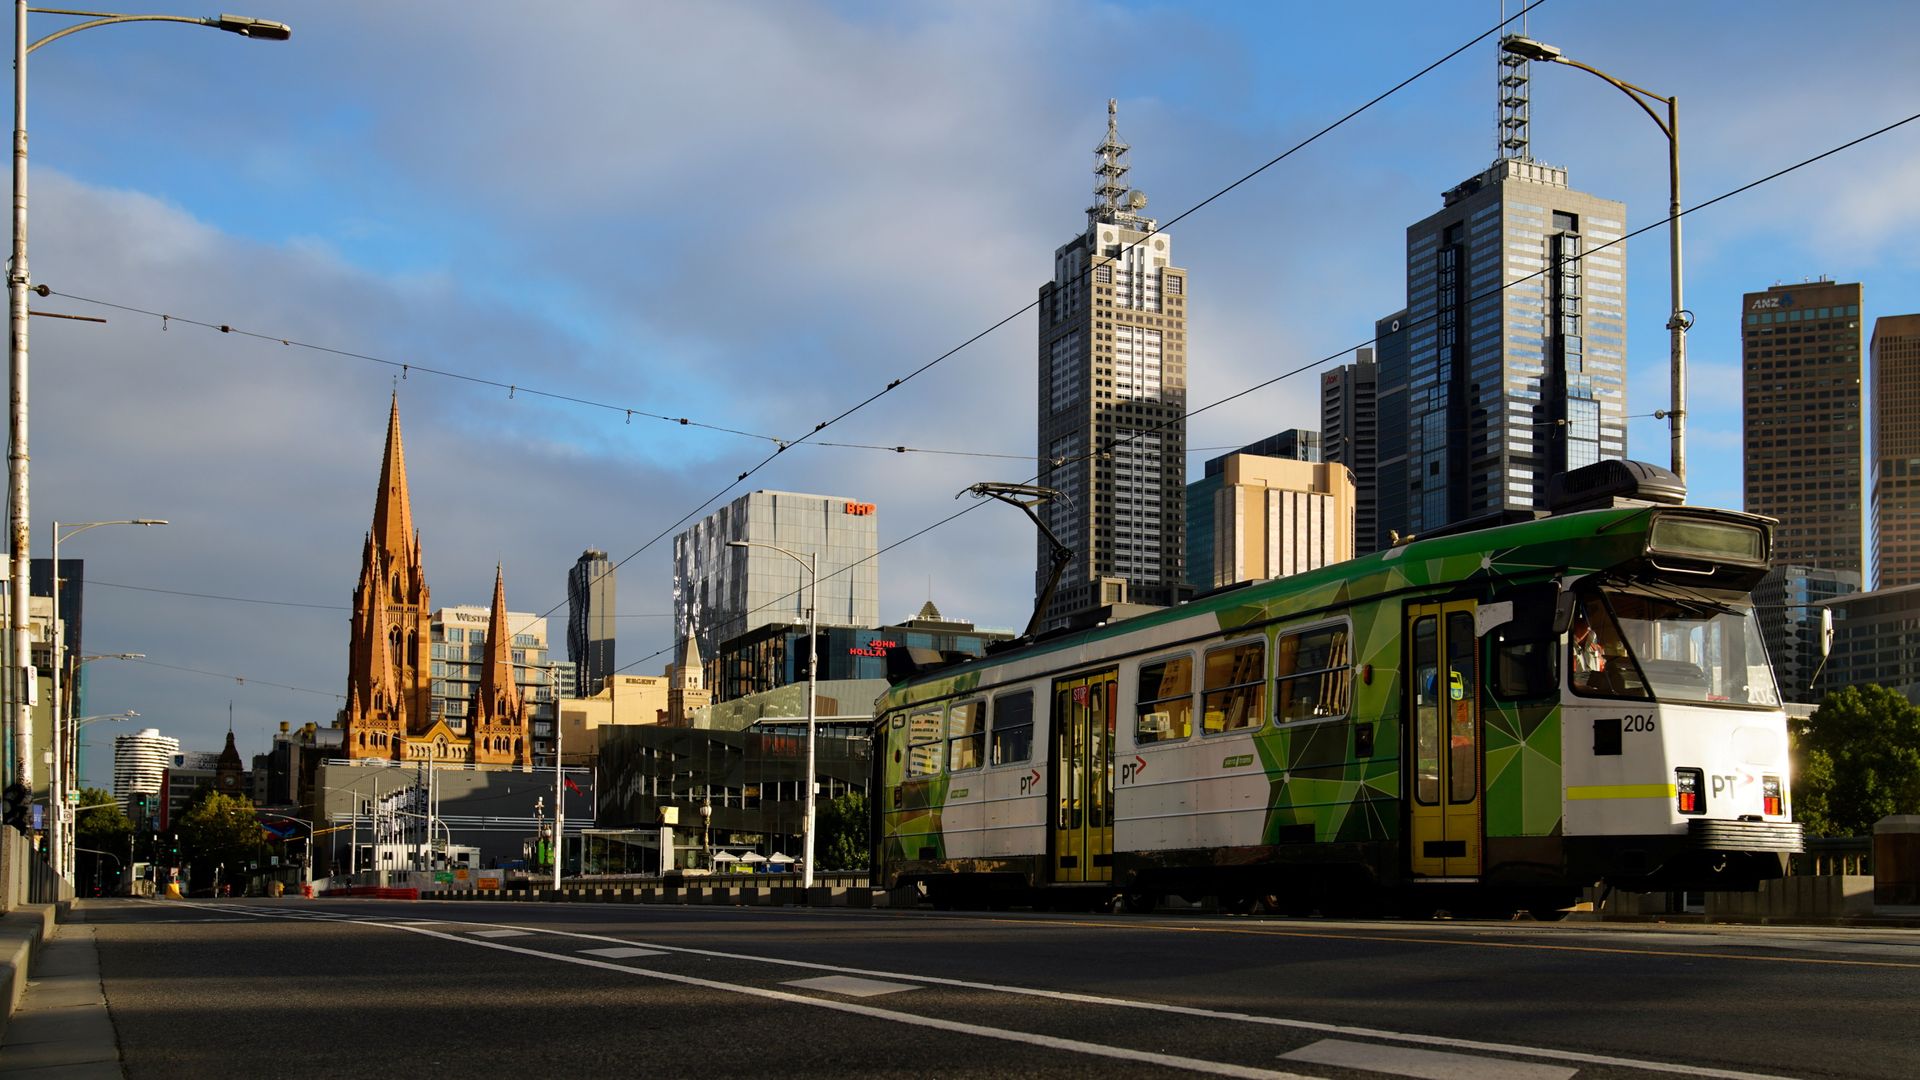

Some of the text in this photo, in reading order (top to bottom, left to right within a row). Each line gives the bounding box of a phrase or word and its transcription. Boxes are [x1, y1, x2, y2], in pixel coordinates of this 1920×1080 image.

[1752, 298, 1779, 309] ANZ
[845, 502, 875, 516] BHP
[869, 640, 896, 648] JOHN
[849, 648, 887, 656] HOLLAN
[1073, 687, 1087, 700] STOP
[1743, 685, 1777, 705] 206
[1623, 714, 1655, 732] 206
